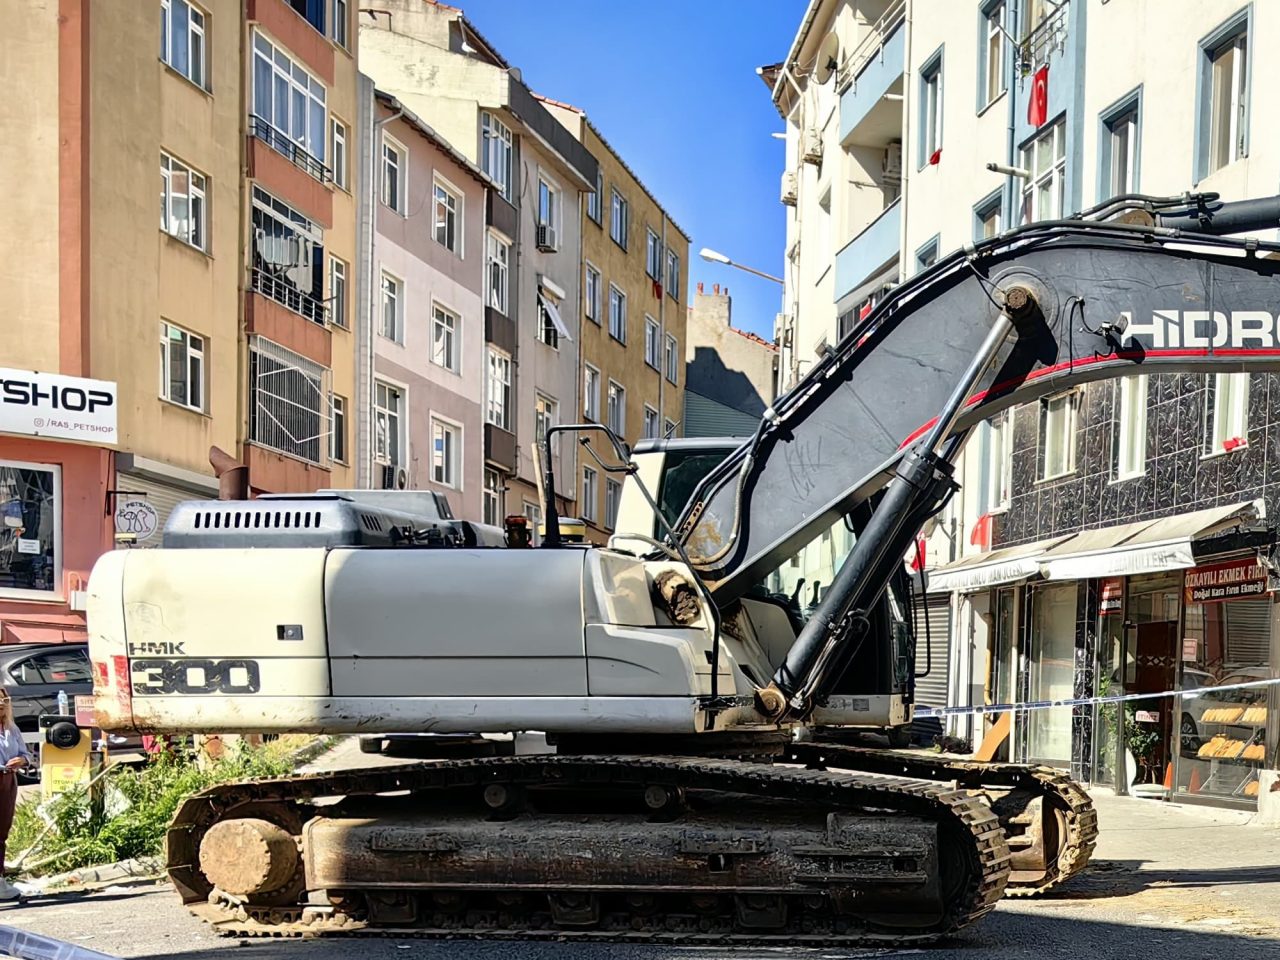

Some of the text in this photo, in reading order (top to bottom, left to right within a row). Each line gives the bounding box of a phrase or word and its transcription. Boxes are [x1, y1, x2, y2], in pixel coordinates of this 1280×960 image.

[0, 379, 114, 413] SHOP
[1218, 566, 1246, 583] EKMEK
[129, 641, 186, 656] HMK
[132, 659, 261, 695] 300
